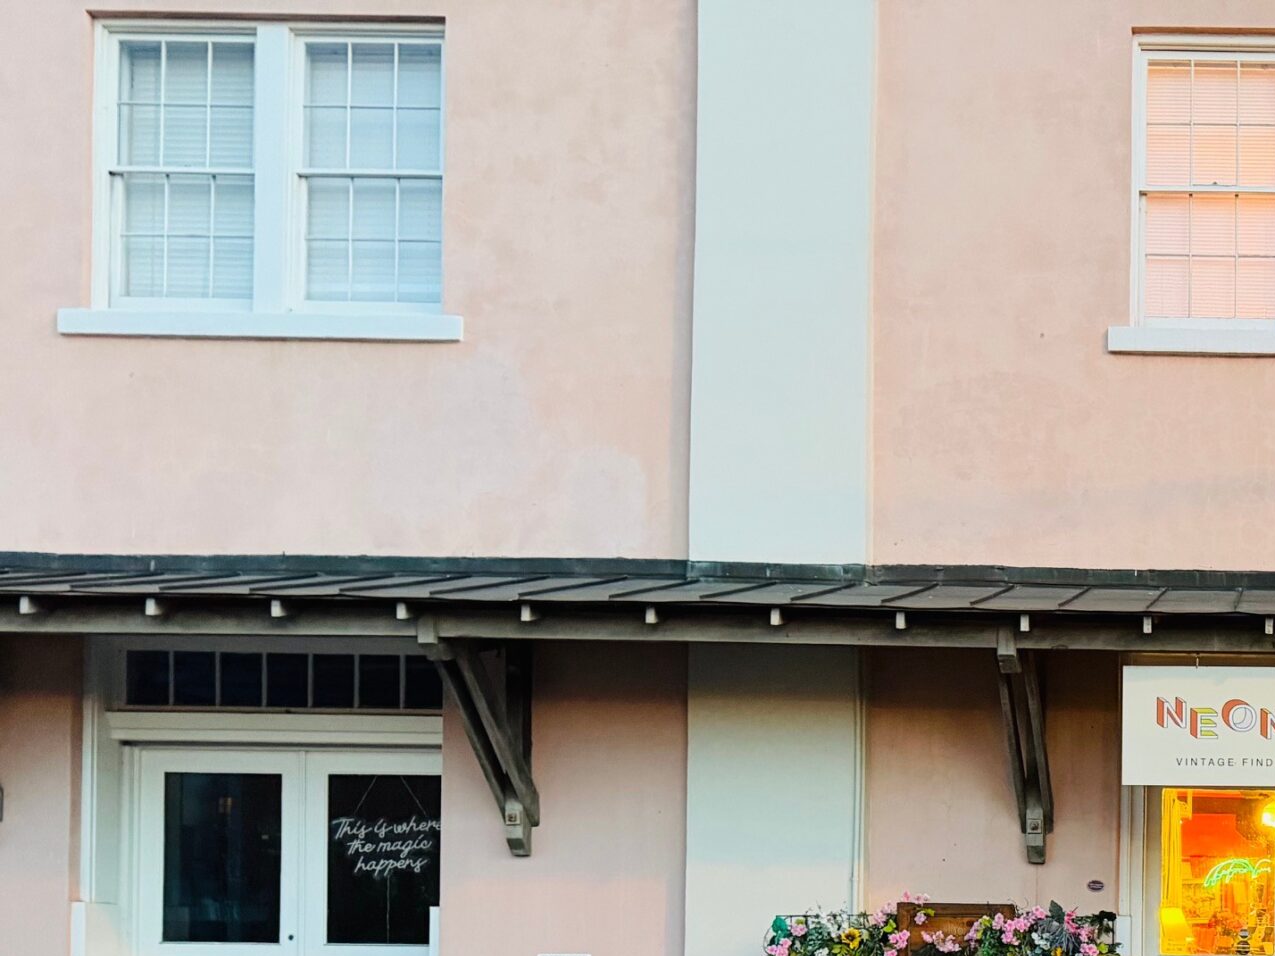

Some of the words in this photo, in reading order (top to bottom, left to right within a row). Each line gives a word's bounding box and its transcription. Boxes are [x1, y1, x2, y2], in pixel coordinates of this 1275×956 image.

[1176, 757, 1235, 767] VINTAGE
[332, 817, 372, 839] This
[374, 818, 392, 838] is
[347, 839, 375, 855] the
[377, 834, 432, 858] magic
[354, 856, 428, 877] happens
